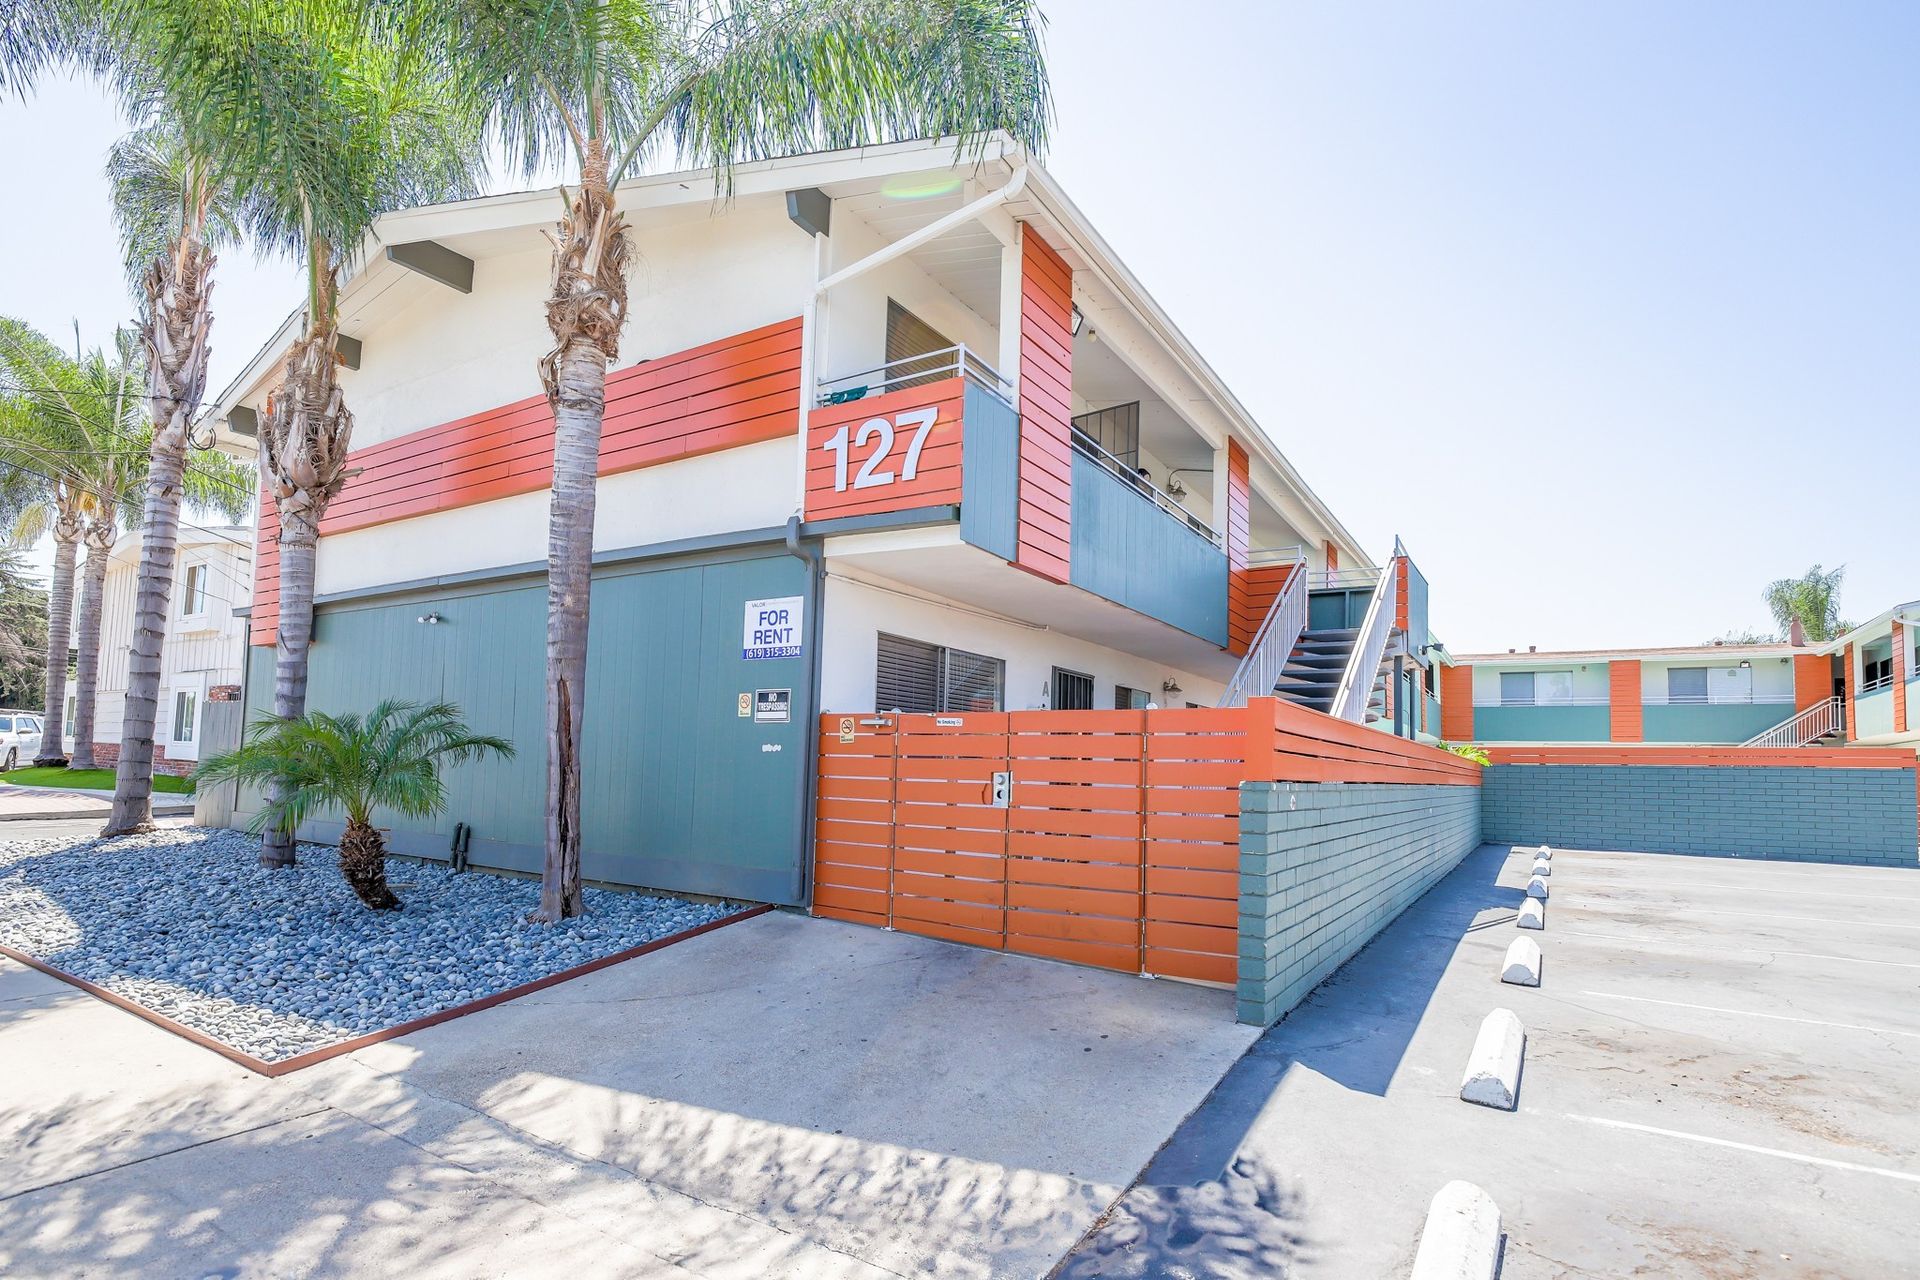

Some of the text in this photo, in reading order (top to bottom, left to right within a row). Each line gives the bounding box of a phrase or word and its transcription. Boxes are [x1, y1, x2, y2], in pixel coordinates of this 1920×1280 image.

[823, 406, 938, 492] 127
[759, 609, 789, 626] FOR
[753, 628, 793, 645] RENT
[746, 646, 800, 658] (619) 315-3304
[768, 692, 778, 702] NO
[1042, 681, 1049, 697] A
[758, 702, 788, 711] TRESPASSING
